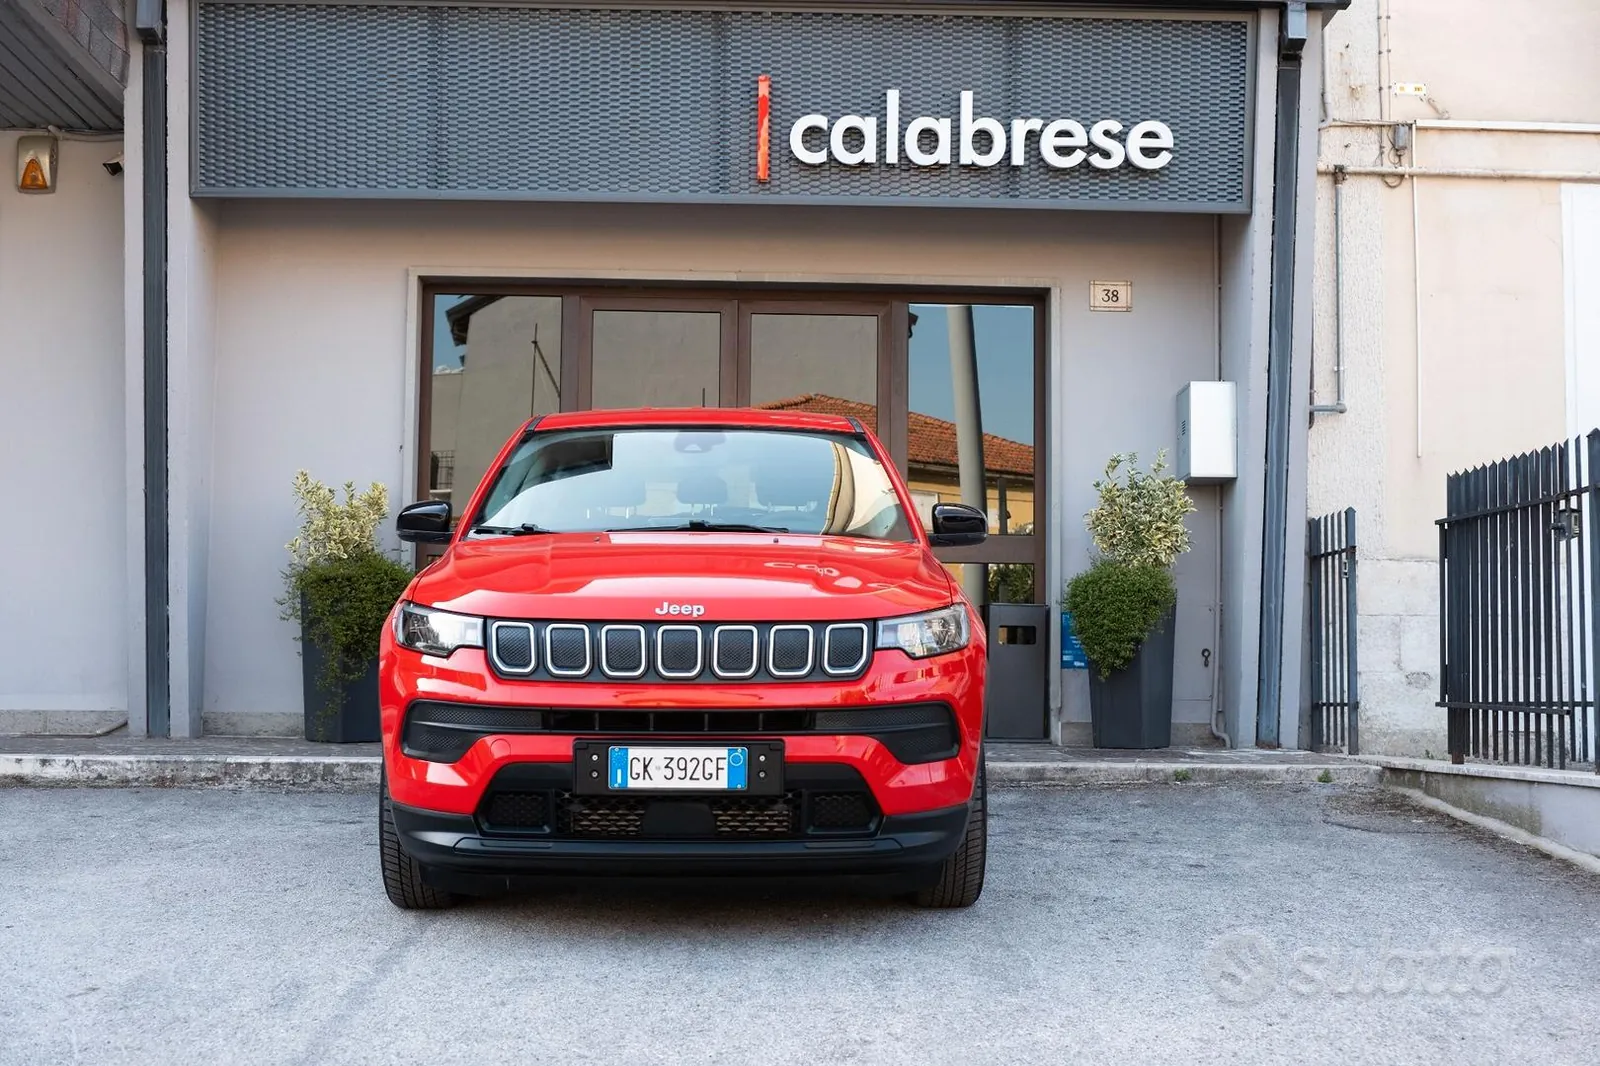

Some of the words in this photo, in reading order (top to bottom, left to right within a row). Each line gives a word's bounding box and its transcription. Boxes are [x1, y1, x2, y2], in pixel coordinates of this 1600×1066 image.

[789, 89, 1175, 170] calabrese
[1101, 289, 1119, 302] 38
[655, 601, 705, 617] Jeep
[629, 756, 654, 781] GK
[663, 756, 728, 781] 392GF
